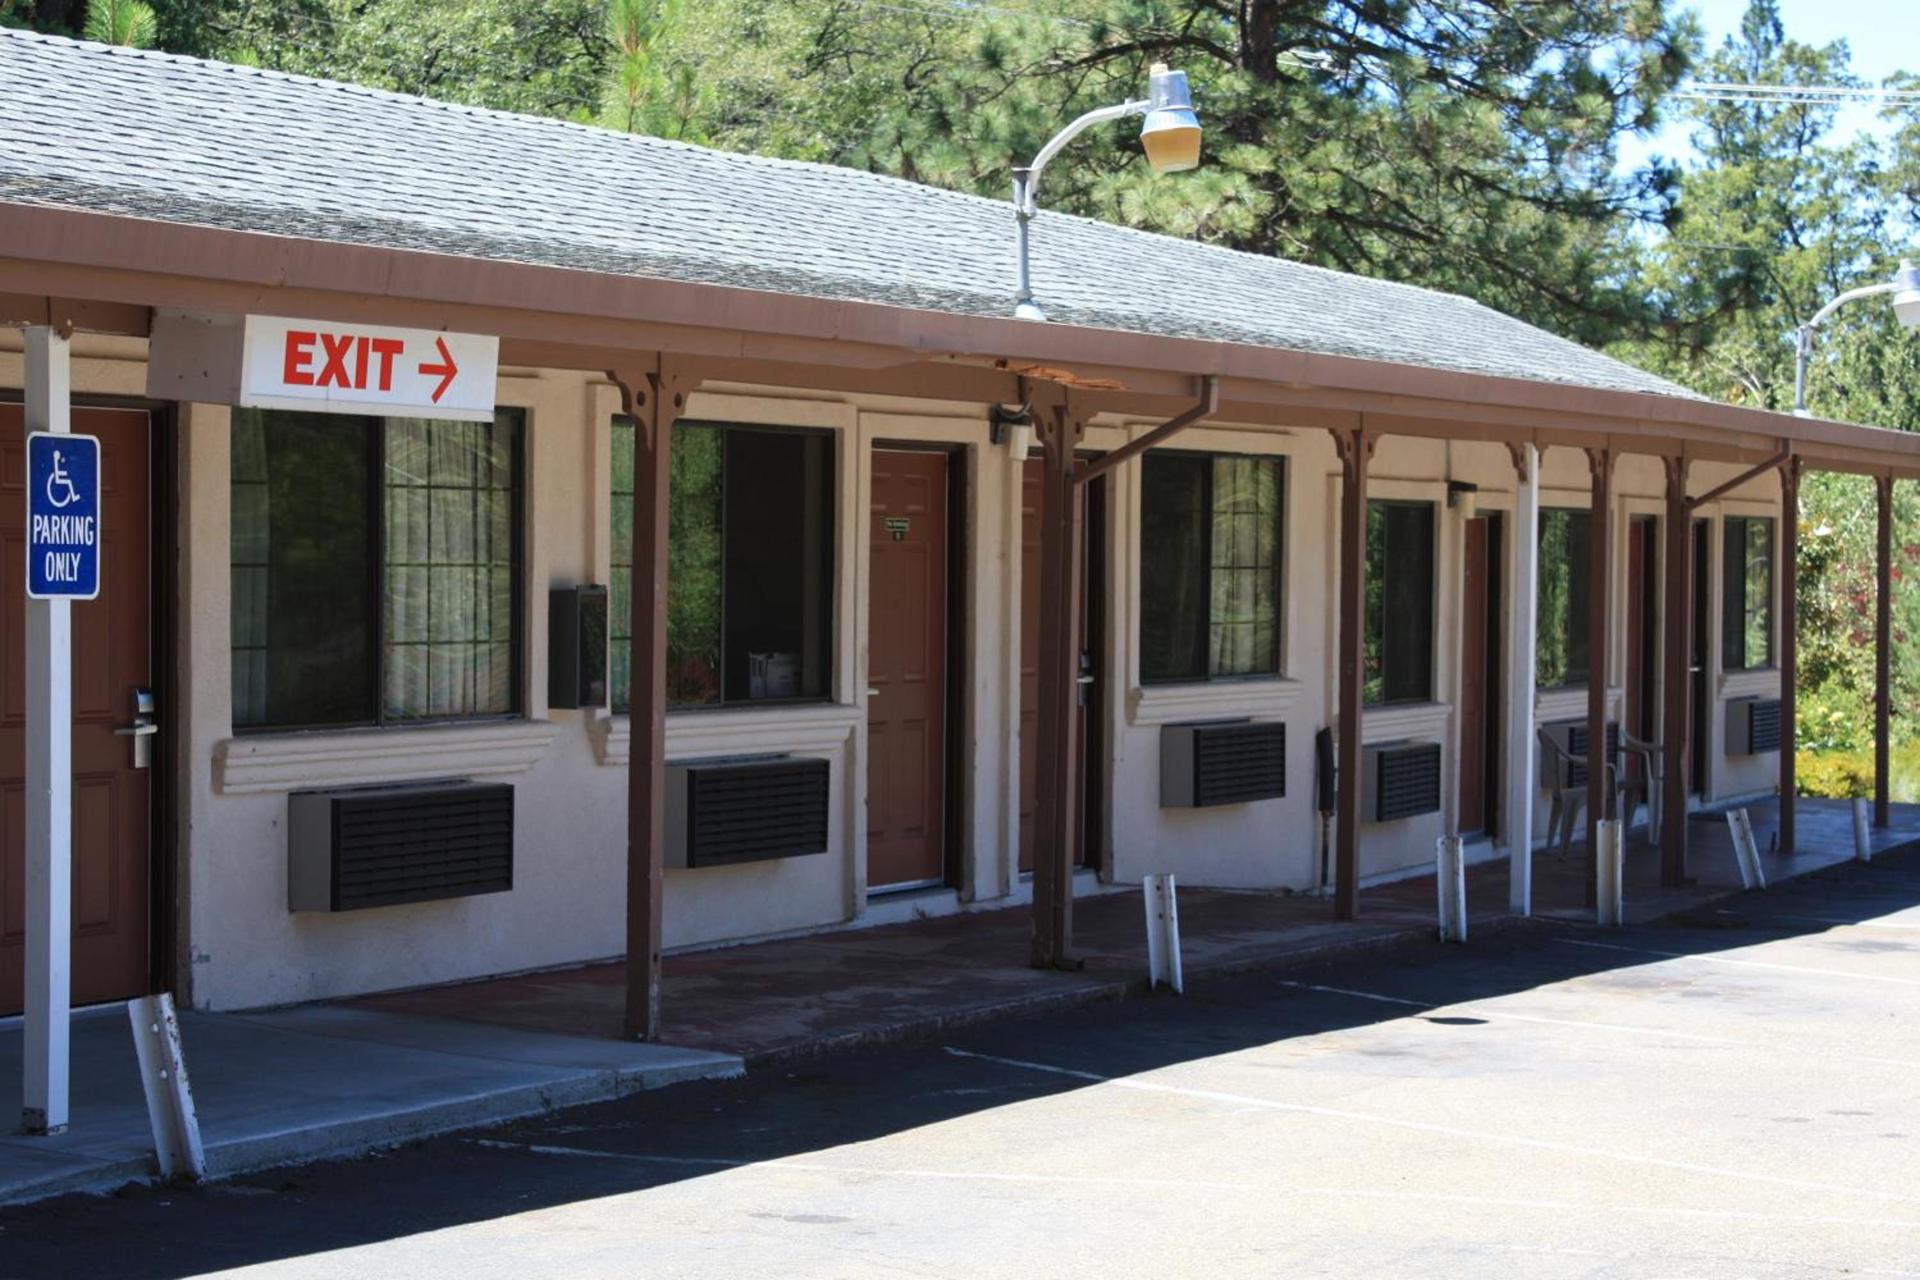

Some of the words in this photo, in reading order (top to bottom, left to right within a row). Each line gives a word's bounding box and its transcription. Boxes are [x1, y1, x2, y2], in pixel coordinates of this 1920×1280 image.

[283, 330, 404, 391] EXIT
[33, 514, 94, 546] PARKING
[45, 551, 81, 582] ONLY
